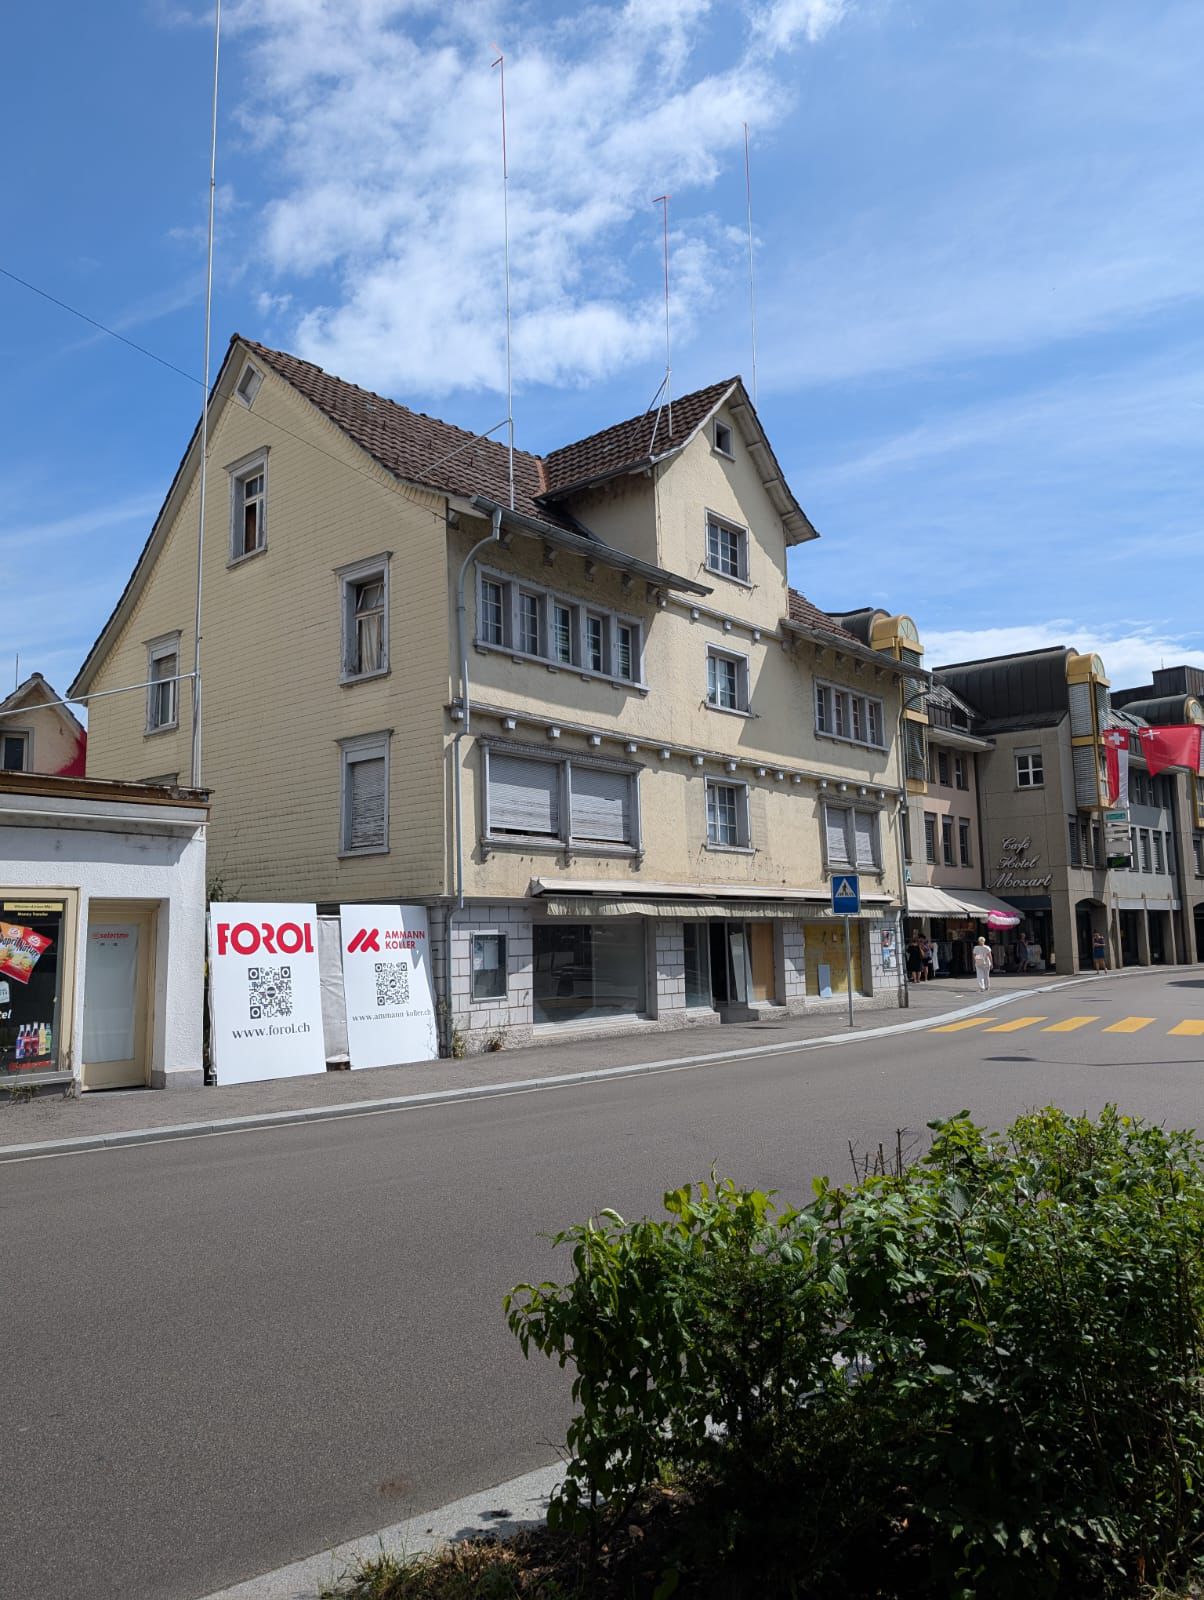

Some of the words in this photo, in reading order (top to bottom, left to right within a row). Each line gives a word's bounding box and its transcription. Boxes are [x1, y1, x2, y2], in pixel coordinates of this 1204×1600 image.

[1002, 836, 1031, 854] Café
[996, 855, 1040, 869] Hotel
[987, 872, 1052, 889] Mozart
[217, 922, 314, 955] FOROL
[385, 930, 425, 940] AMMANN
[385, 941, 416, 950] KOLLER
[352, 1008, 431, 1021] www.ammannkoller.ch
[232, 1022, 310, 1039] www.forol.ch
